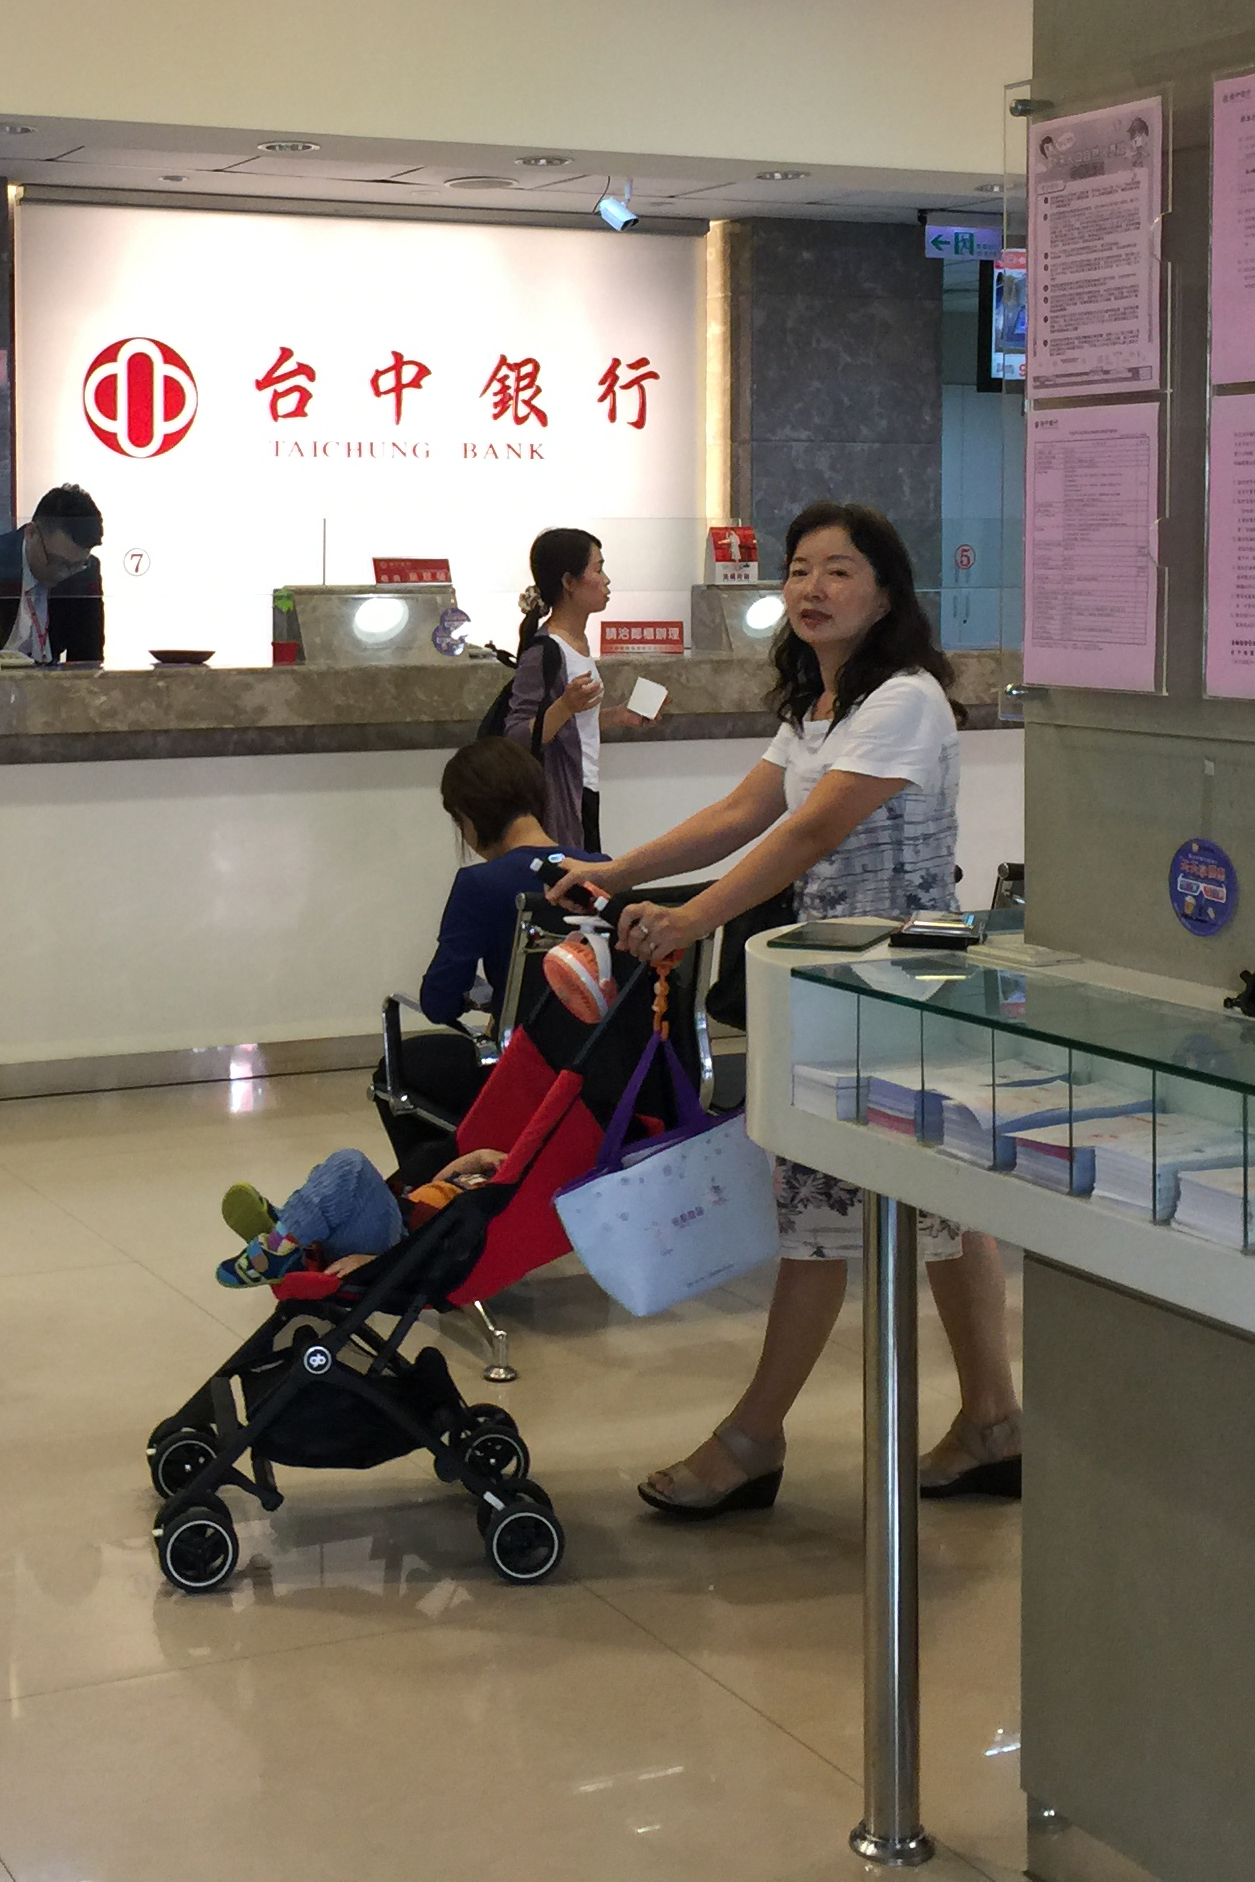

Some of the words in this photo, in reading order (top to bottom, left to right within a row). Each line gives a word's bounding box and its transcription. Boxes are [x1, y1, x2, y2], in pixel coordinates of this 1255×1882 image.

[255, 346, 661, 430] 台中銀行
[268, 440, 431, 460] TAICHUNG
[461, 442, 546, 460] BANK
[130, 553, 144, 573] 7
[959, 548, 971, 567] 5
